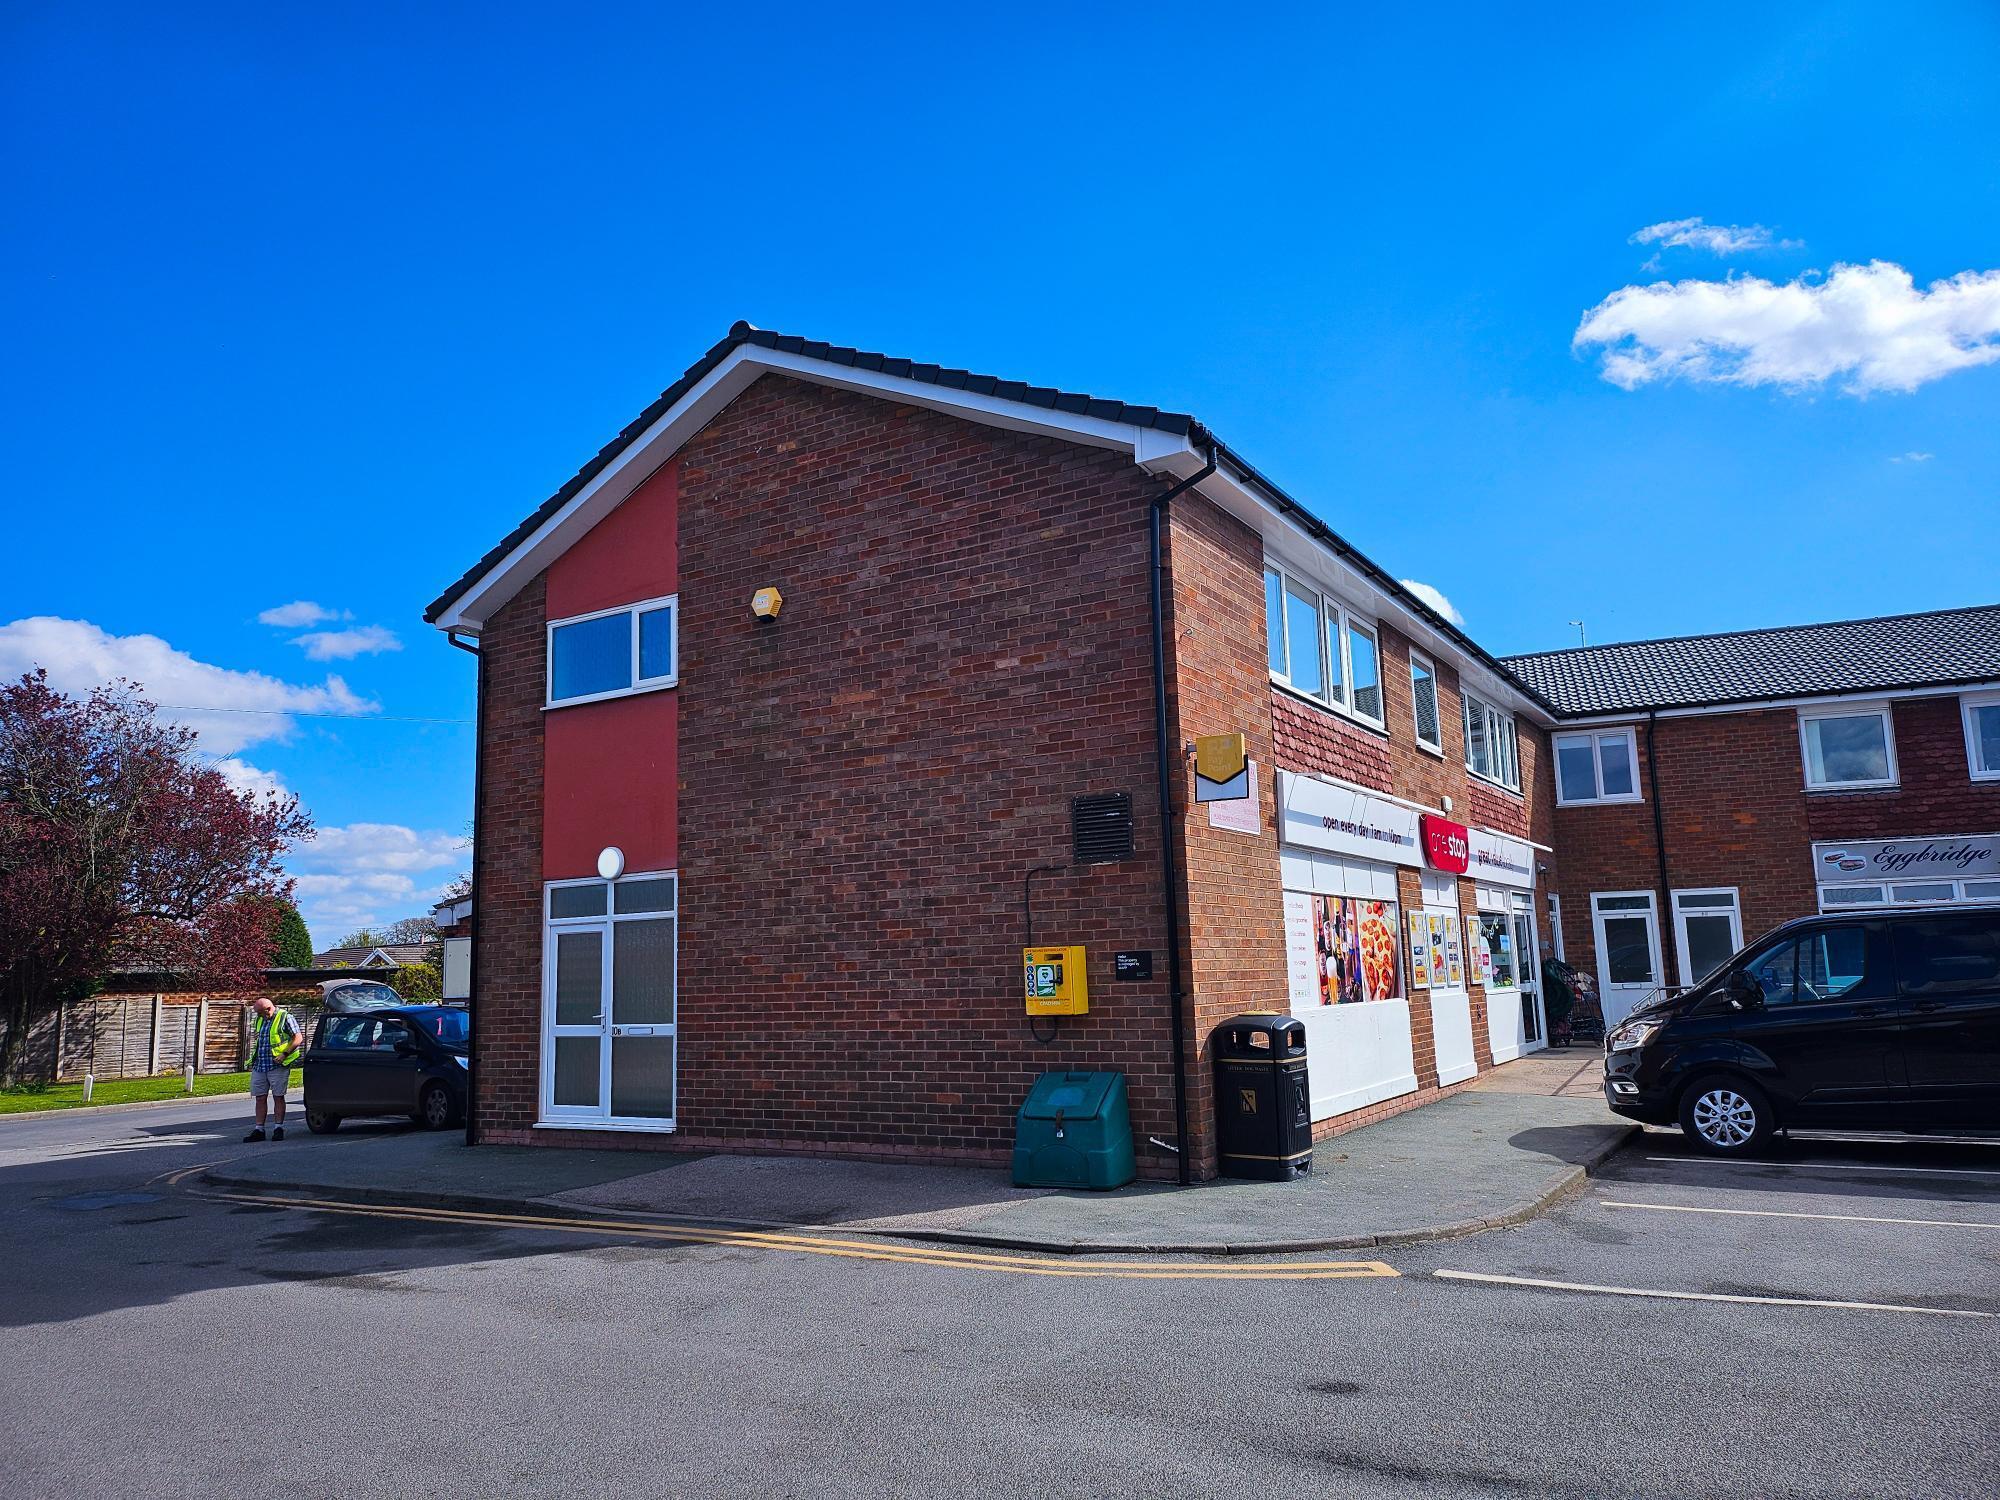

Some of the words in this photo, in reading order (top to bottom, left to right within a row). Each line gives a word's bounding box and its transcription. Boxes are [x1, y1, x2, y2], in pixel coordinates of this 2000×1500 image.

[1322, 815, 1338, 832] open
[1340, 820, 1357, 837] every
[1358, 821, 1369, 839] day
[1448, 832, 1467, 866] stop
[1873, 844, 1992, 872] Eggbridge
